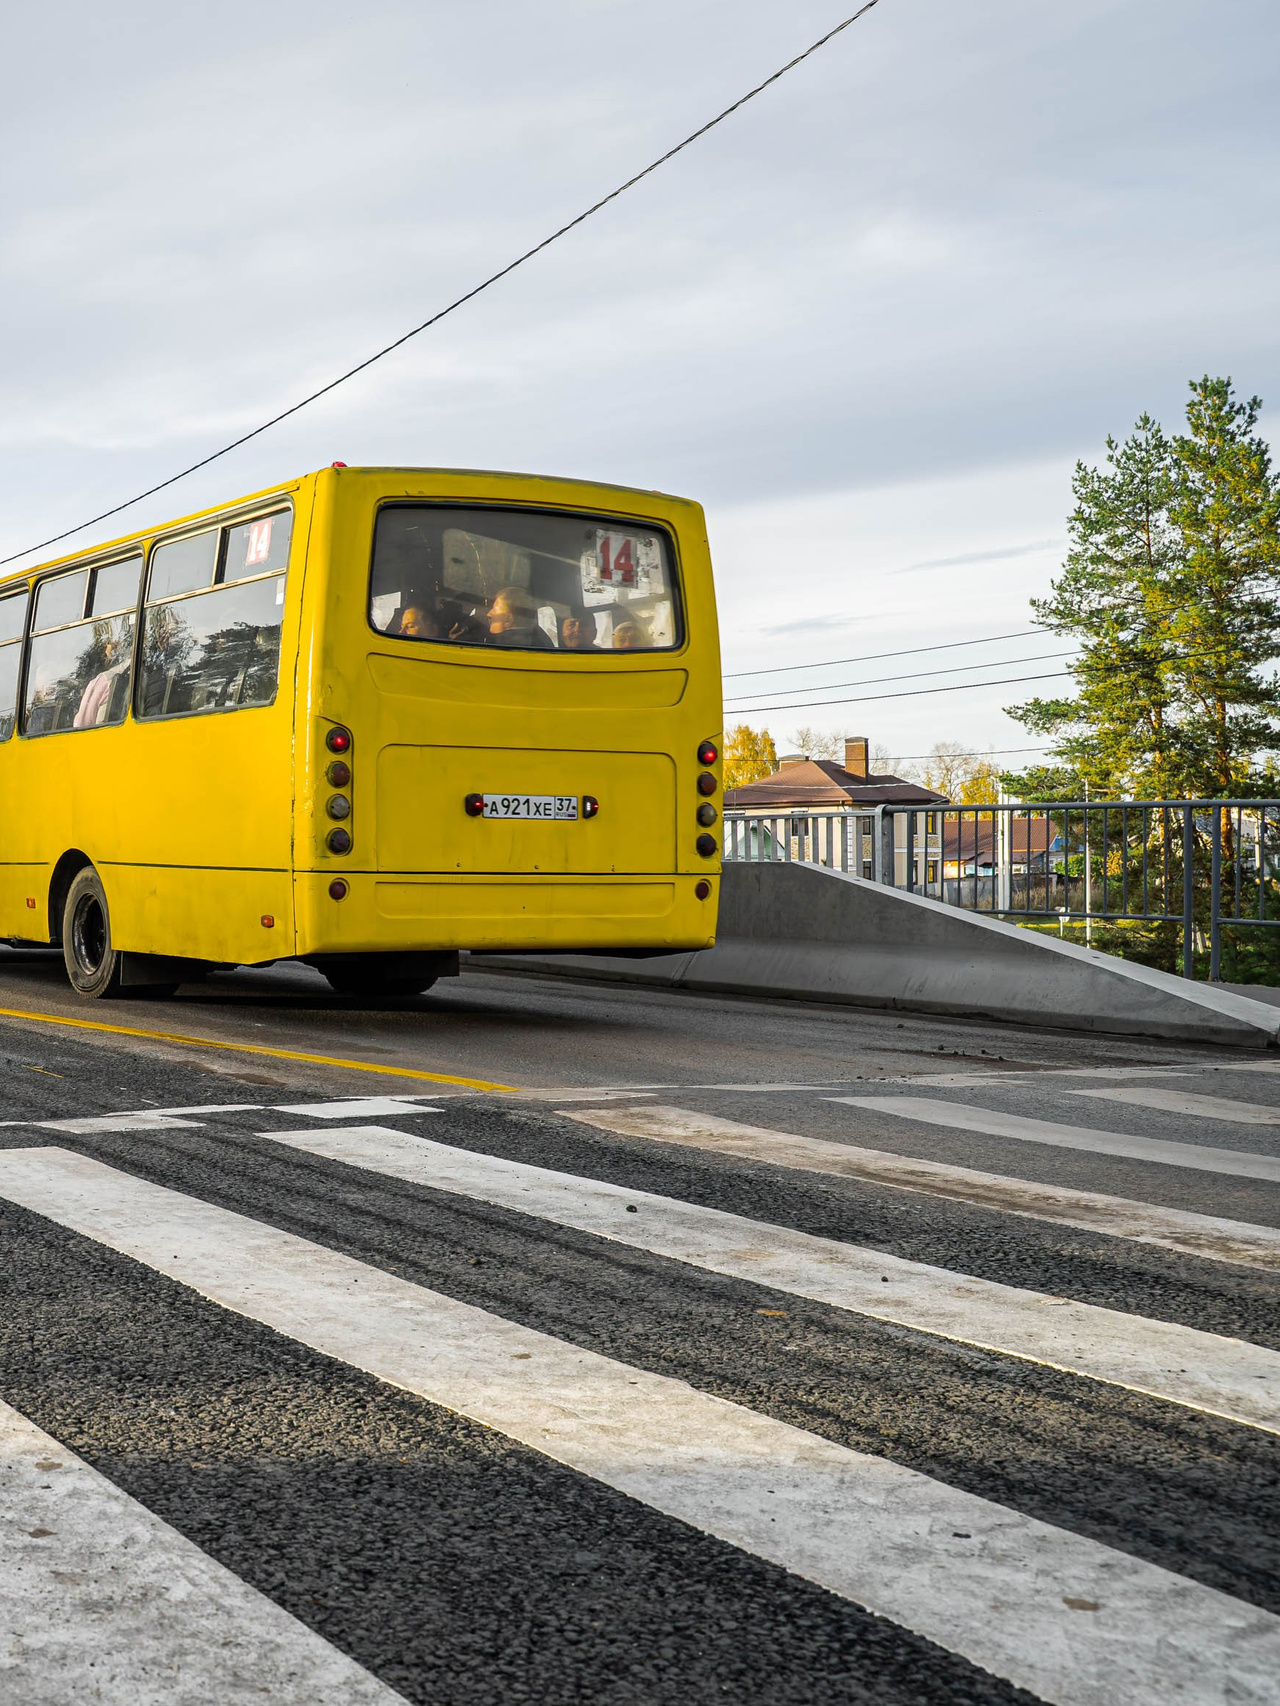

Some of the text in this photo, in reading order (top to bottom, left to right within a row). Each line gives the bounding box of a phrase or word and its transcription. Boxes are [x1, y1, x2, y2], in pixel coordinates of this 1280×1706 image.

[248, 522, 269, 562] 14
[600, 536, 634, 583] 14
[556, 798, 572, 812] 37
